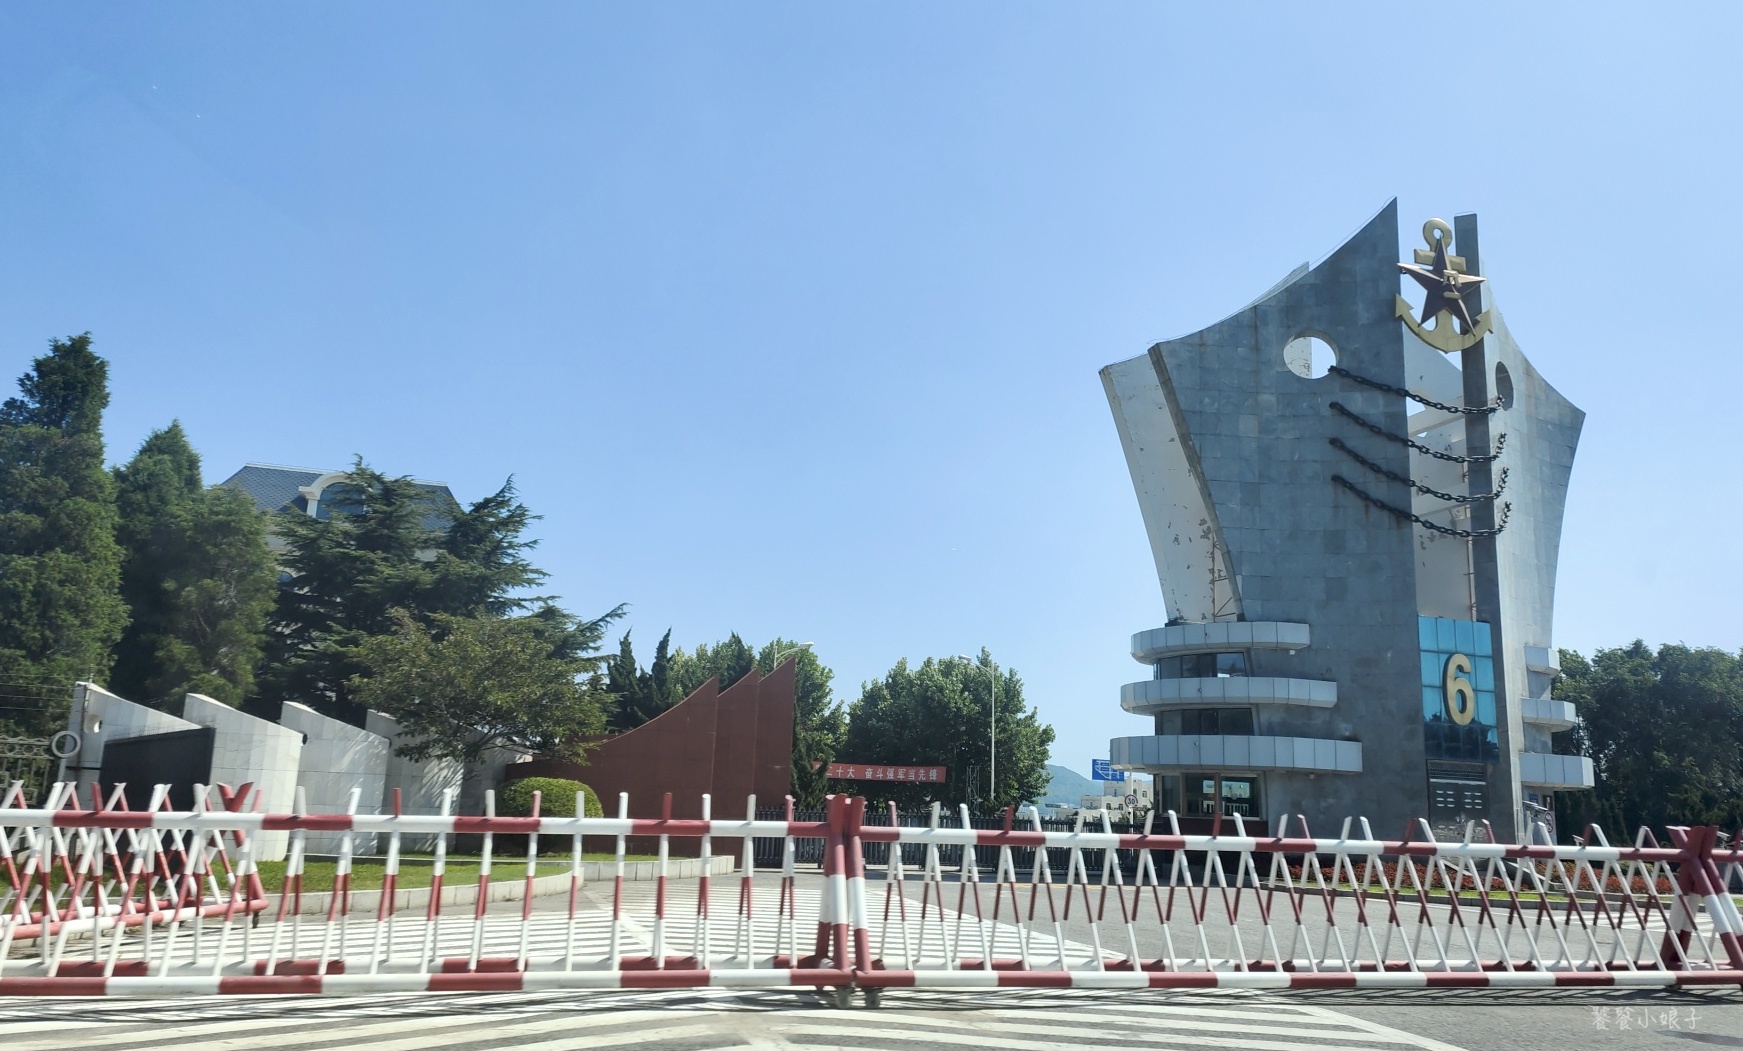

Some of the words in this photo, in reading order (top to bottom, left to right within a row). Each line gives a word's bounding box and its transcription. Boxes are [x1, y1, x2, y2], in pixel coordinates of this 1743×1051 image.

[1443, 653, 1474, 725] 6
[815, 764, 855, 778] 二十大
[865, 767, 938, 781] 奋斗强军当先锋
